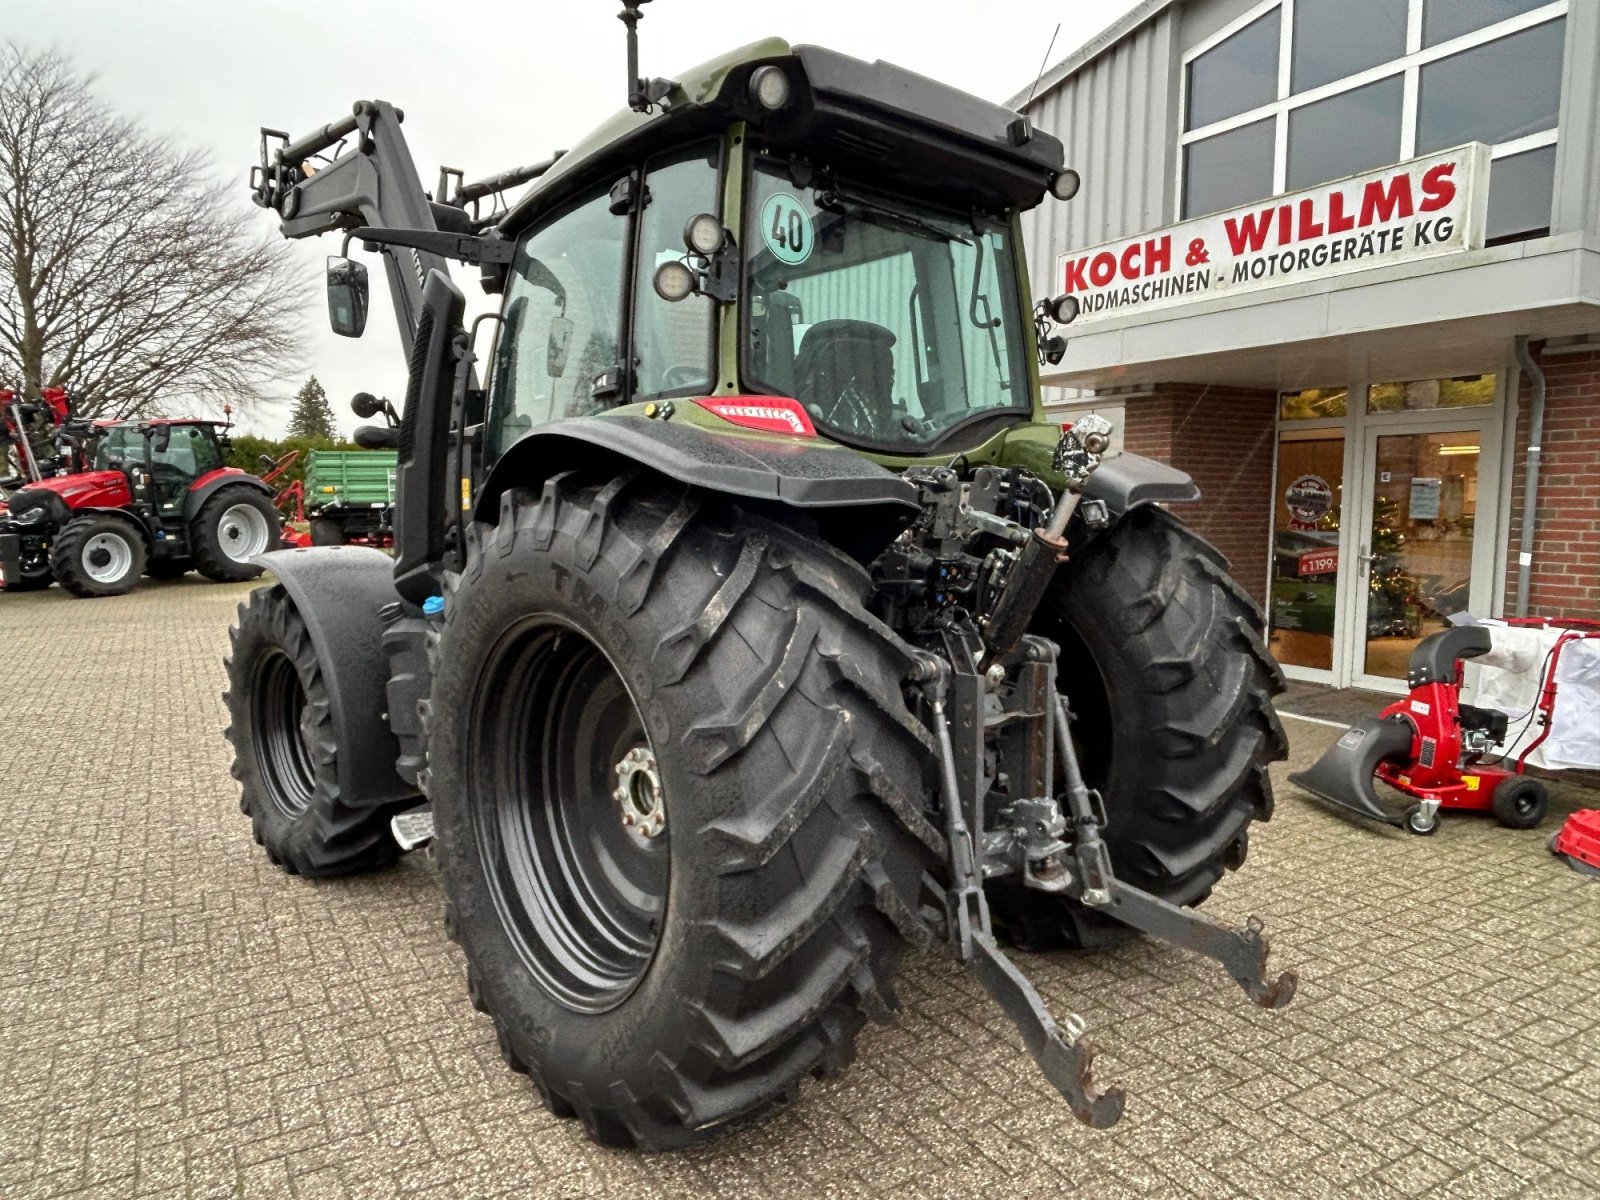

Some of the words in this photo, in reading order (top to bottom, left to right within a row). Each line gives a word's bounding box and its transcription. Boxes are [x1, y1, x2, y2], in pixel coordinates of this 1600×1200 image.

[771, 204, 803, 253] 40
[1065, 235, 1171, 294] KOCH
[1185, 238, 1210, 267] &
[1224, 162, 1457, 256] WILLMS
[1076, 269, 1210, 315] NDMASCHINEN
[1232, 226, 1404, 284] MOTORGERÄTE
[1414, 216, 1454, 247] KG
